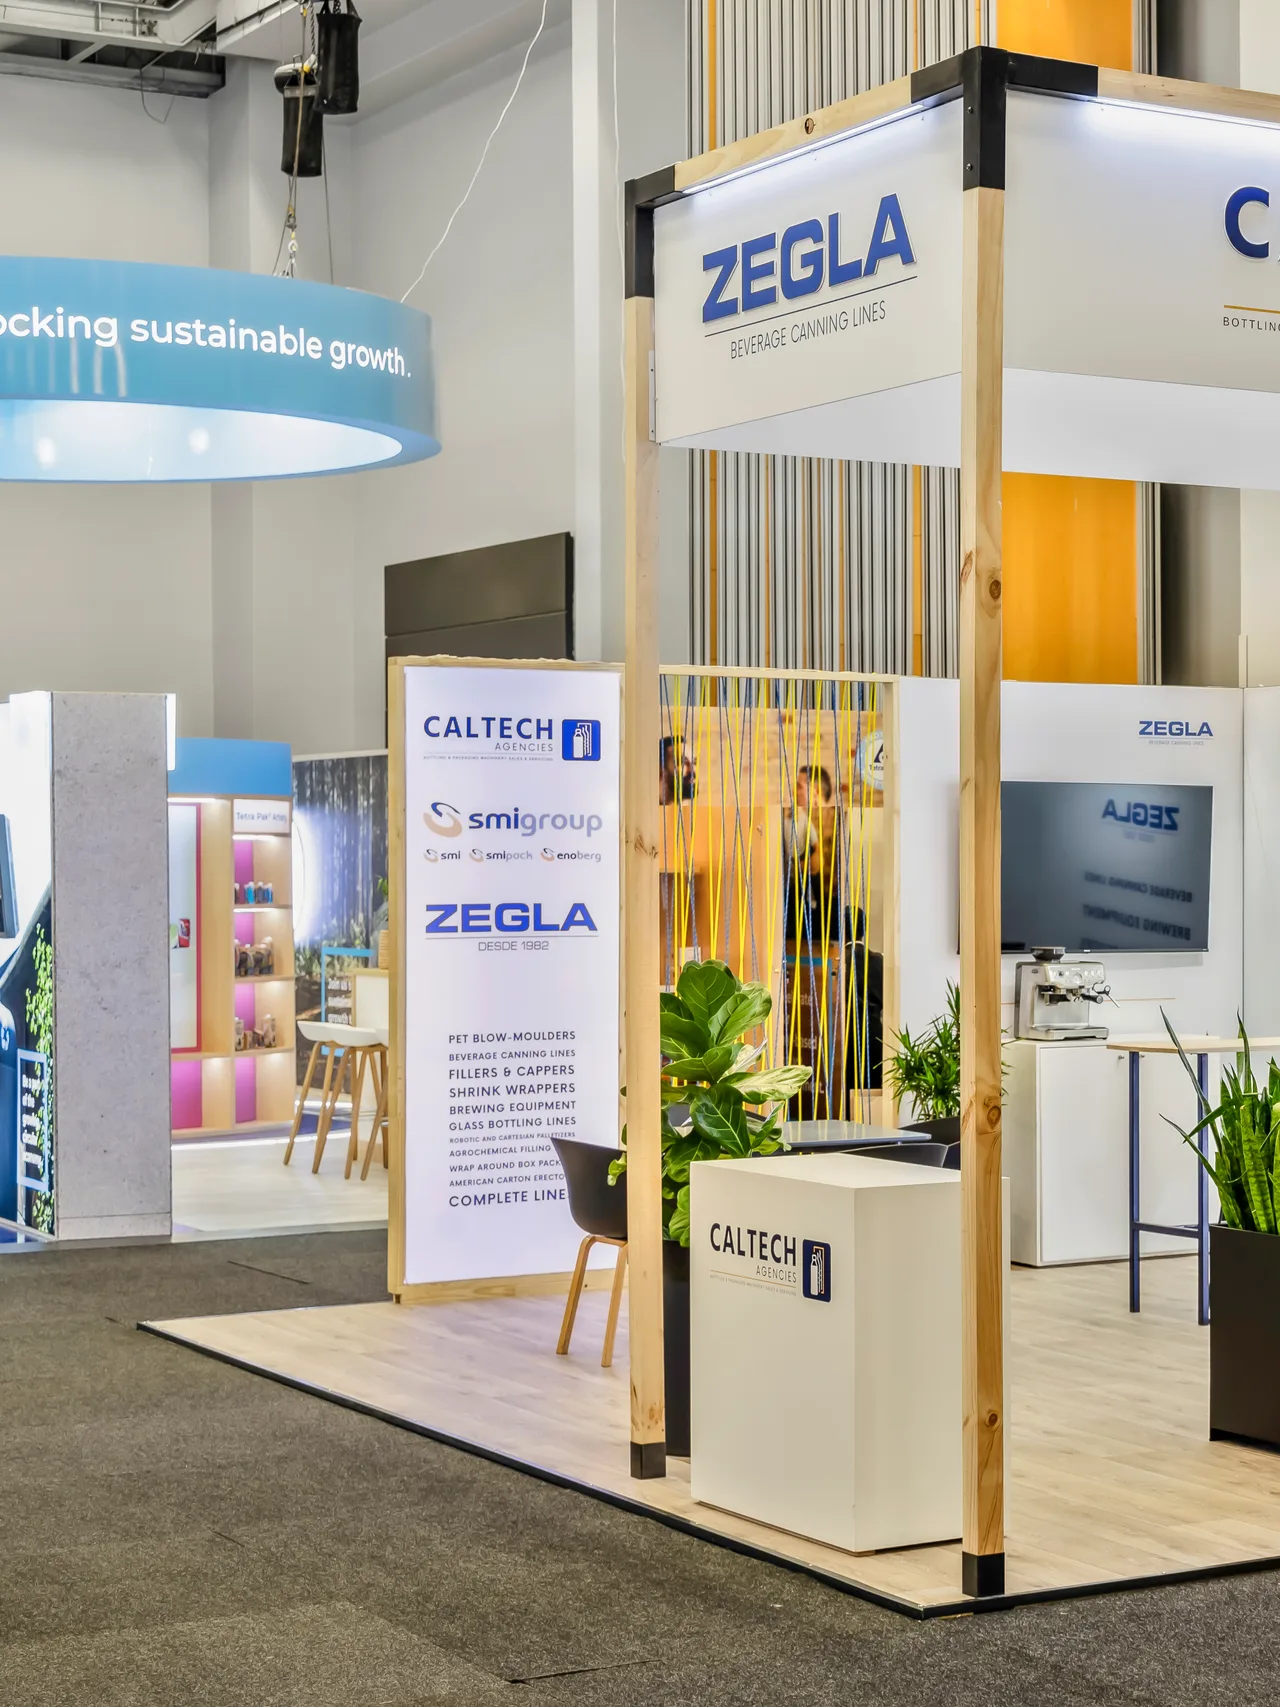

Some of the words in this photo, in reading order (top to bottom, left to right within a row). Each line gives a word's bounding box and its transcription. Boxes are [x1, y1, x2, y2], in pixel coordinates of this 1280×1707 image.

[703, 193, 917, 323] ZEGLA
[730, 327, 787, 360] BEVERAGE
[790, 310, 849, 344] CANNING
[852, 300, 887, 328] LINES
[130, 315, 323, 359] sustainable
[330, 338, 411, 378] growth.
[423, 715, 553, 740] CALTECH
[1138, 720, 1214, 737] ZEGLA
[494, 742, 553, 752] AGENCIES
[468, 807, 603, 837] smigroup
[441, 851, 461, 860] smi
[486, 850, 533, 863] smipack
[557, 851, 602, 863] enoberg
[425, 902, 598, 933] ZEGLA
[478, 941, 518, 952] DESDE
[520, 940, 550, 951] 1982
[449, 1034, 469, 1044] PET
[473, 1031, 576, 1043] BLOW-MOULDERS
[449, 1051, 498, 1061] BEVERAGE
[501, 1050, 547, 1060] CANNING
[550, 1050, 576, 1058] LINES
[449, 1068, 498, 1079] FILLERS
[503, 1067, 511, 1077] &
[516, 1065, 575, 1077] CAPPERS
[449, 1085, 501, 1098] SHRINK
[506, 1083, 576, 1095] WRAPPERS
[449, 1103, 505, 1115] BREWING
[509, 1100, 576, 1112] EQUIPMENT
[449, 1120, 484, 1131] GLASS
[488, 1117, 543, 1129] BOTTLING
[546, 1116, 576, 1126] LINES
[449, 1136, 480, 1144] ROBOTIC
[498, 1133, 534, 1141] CARTESIAN
[449, 1146, 517, 1157] AGROCHEMICAL
[520, 1145, 552, 1153] FILLING
[449, 1164, 475, 1172] WRAP
[477, 1162, 515, 1171] AROUND
[518, 1160, 536, 1169] BOX
[538, 1159, 561, 1168] PACK
[449, 1177, 494, 1187] AMERICAN
[497, 1175, 531, 1184] CARTON
[534, 1173, 565, 1182] ERECTO
[449, 1190, 528, 1207] COMPLETE
[534, 1189, 569, 1201] LINE
[710, 1222, 797, 1267] CALTECH
[755, 1265, 797, 1284] AGENCIES
